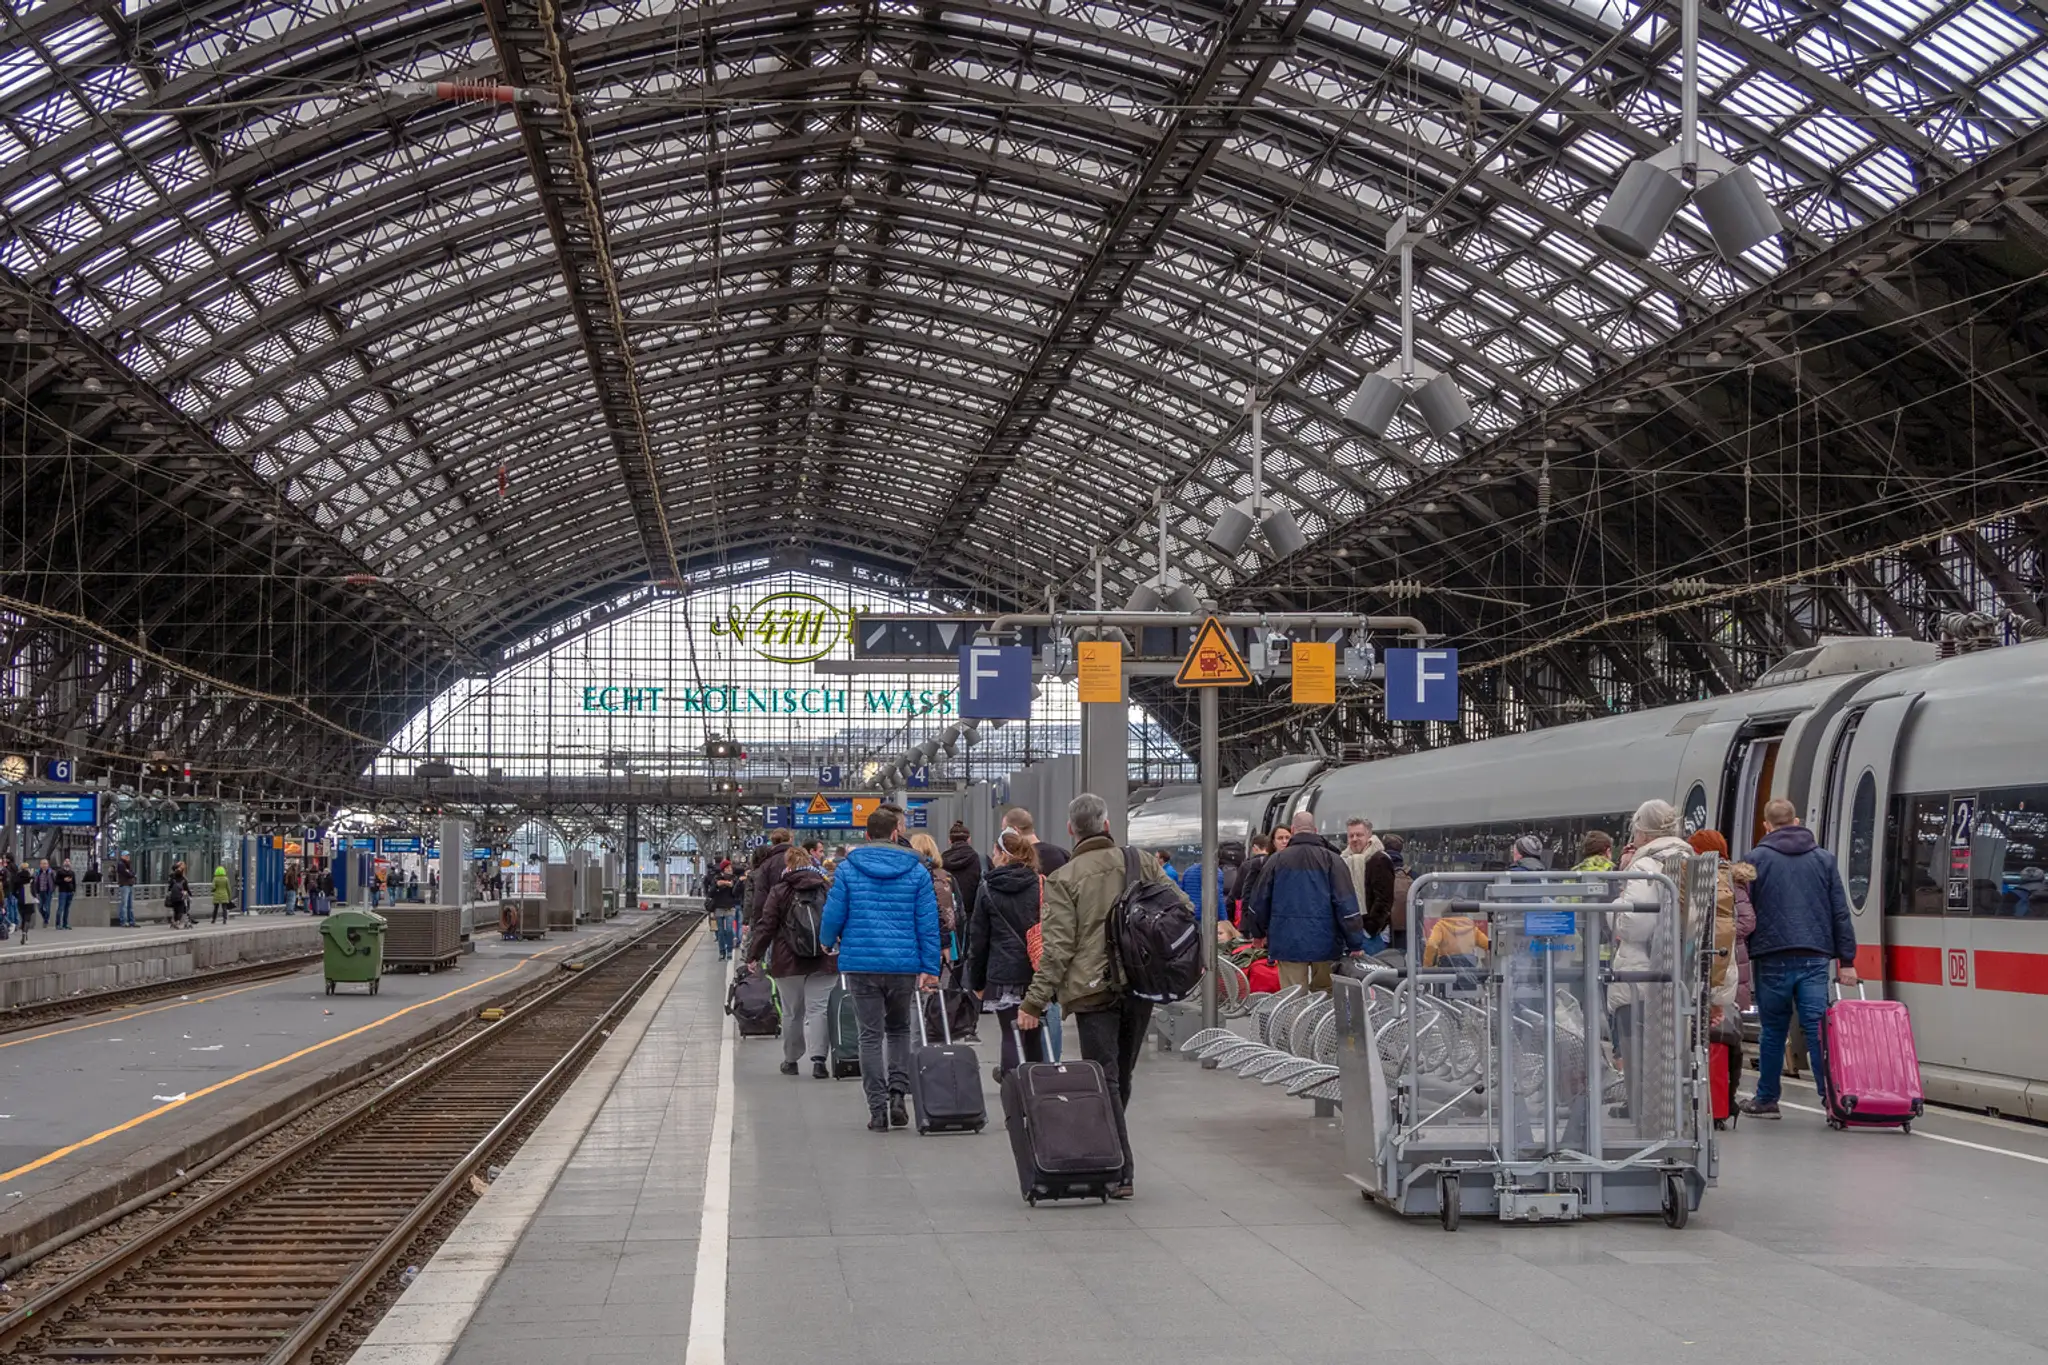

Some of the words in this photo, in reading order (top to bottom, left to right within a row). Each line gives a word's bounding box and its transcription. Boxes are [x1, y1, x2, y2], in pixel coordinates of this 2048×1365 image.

[754, 609, 827, 645] 4711
[970, 649, 1001, 700] F
[1417, 652, 1447, 703] F
[583, 686, 663, 712] ECHT
[684, 684, 845, 714] KÖLNISCH
[56, 761, 68, 778] 6
[822, 767, 832, 783] 5
[914, 766, 926, 782] 4
[767, 807, 778, 824] E
[1954, 803, 1968, 845] 2
[307, 828, 317, 840] D
[755, 835, 764, 847] D
[1950, 953, 1966, 981] DB
